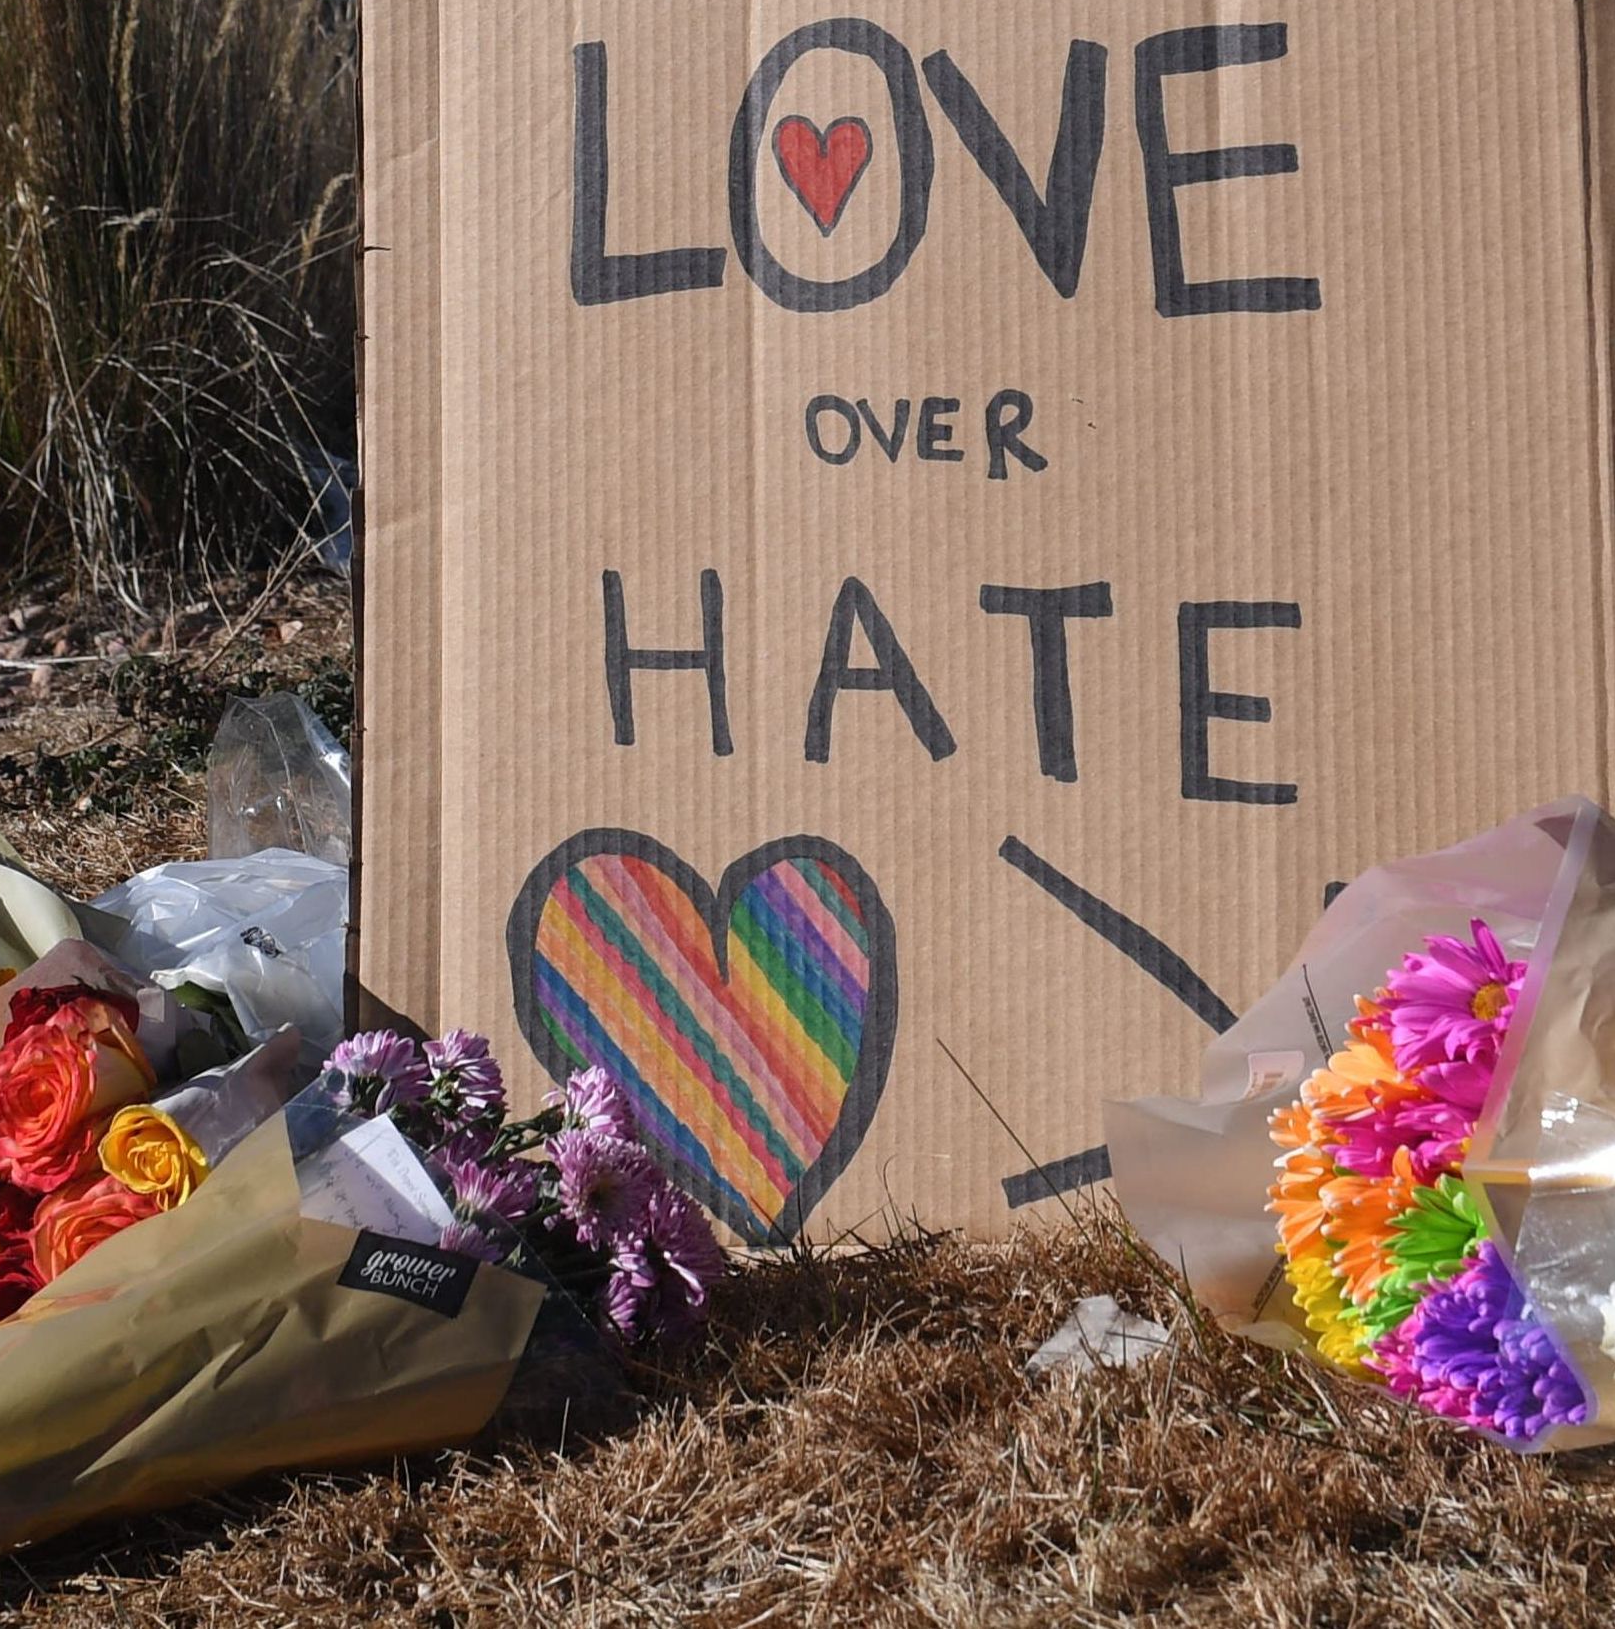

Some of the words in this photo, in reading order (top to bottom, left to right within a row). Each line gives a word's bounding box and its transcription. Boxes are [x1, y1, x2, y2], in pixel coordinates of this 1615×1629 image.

[571, 17, 1322, 318] LOVE
[805, 388, 1048, 480] OVER
[602, 567, 1302, 806] HATE
[360, 1249, 457, 1283] grower
[370, 1270, 439, 1299] BUNCH
